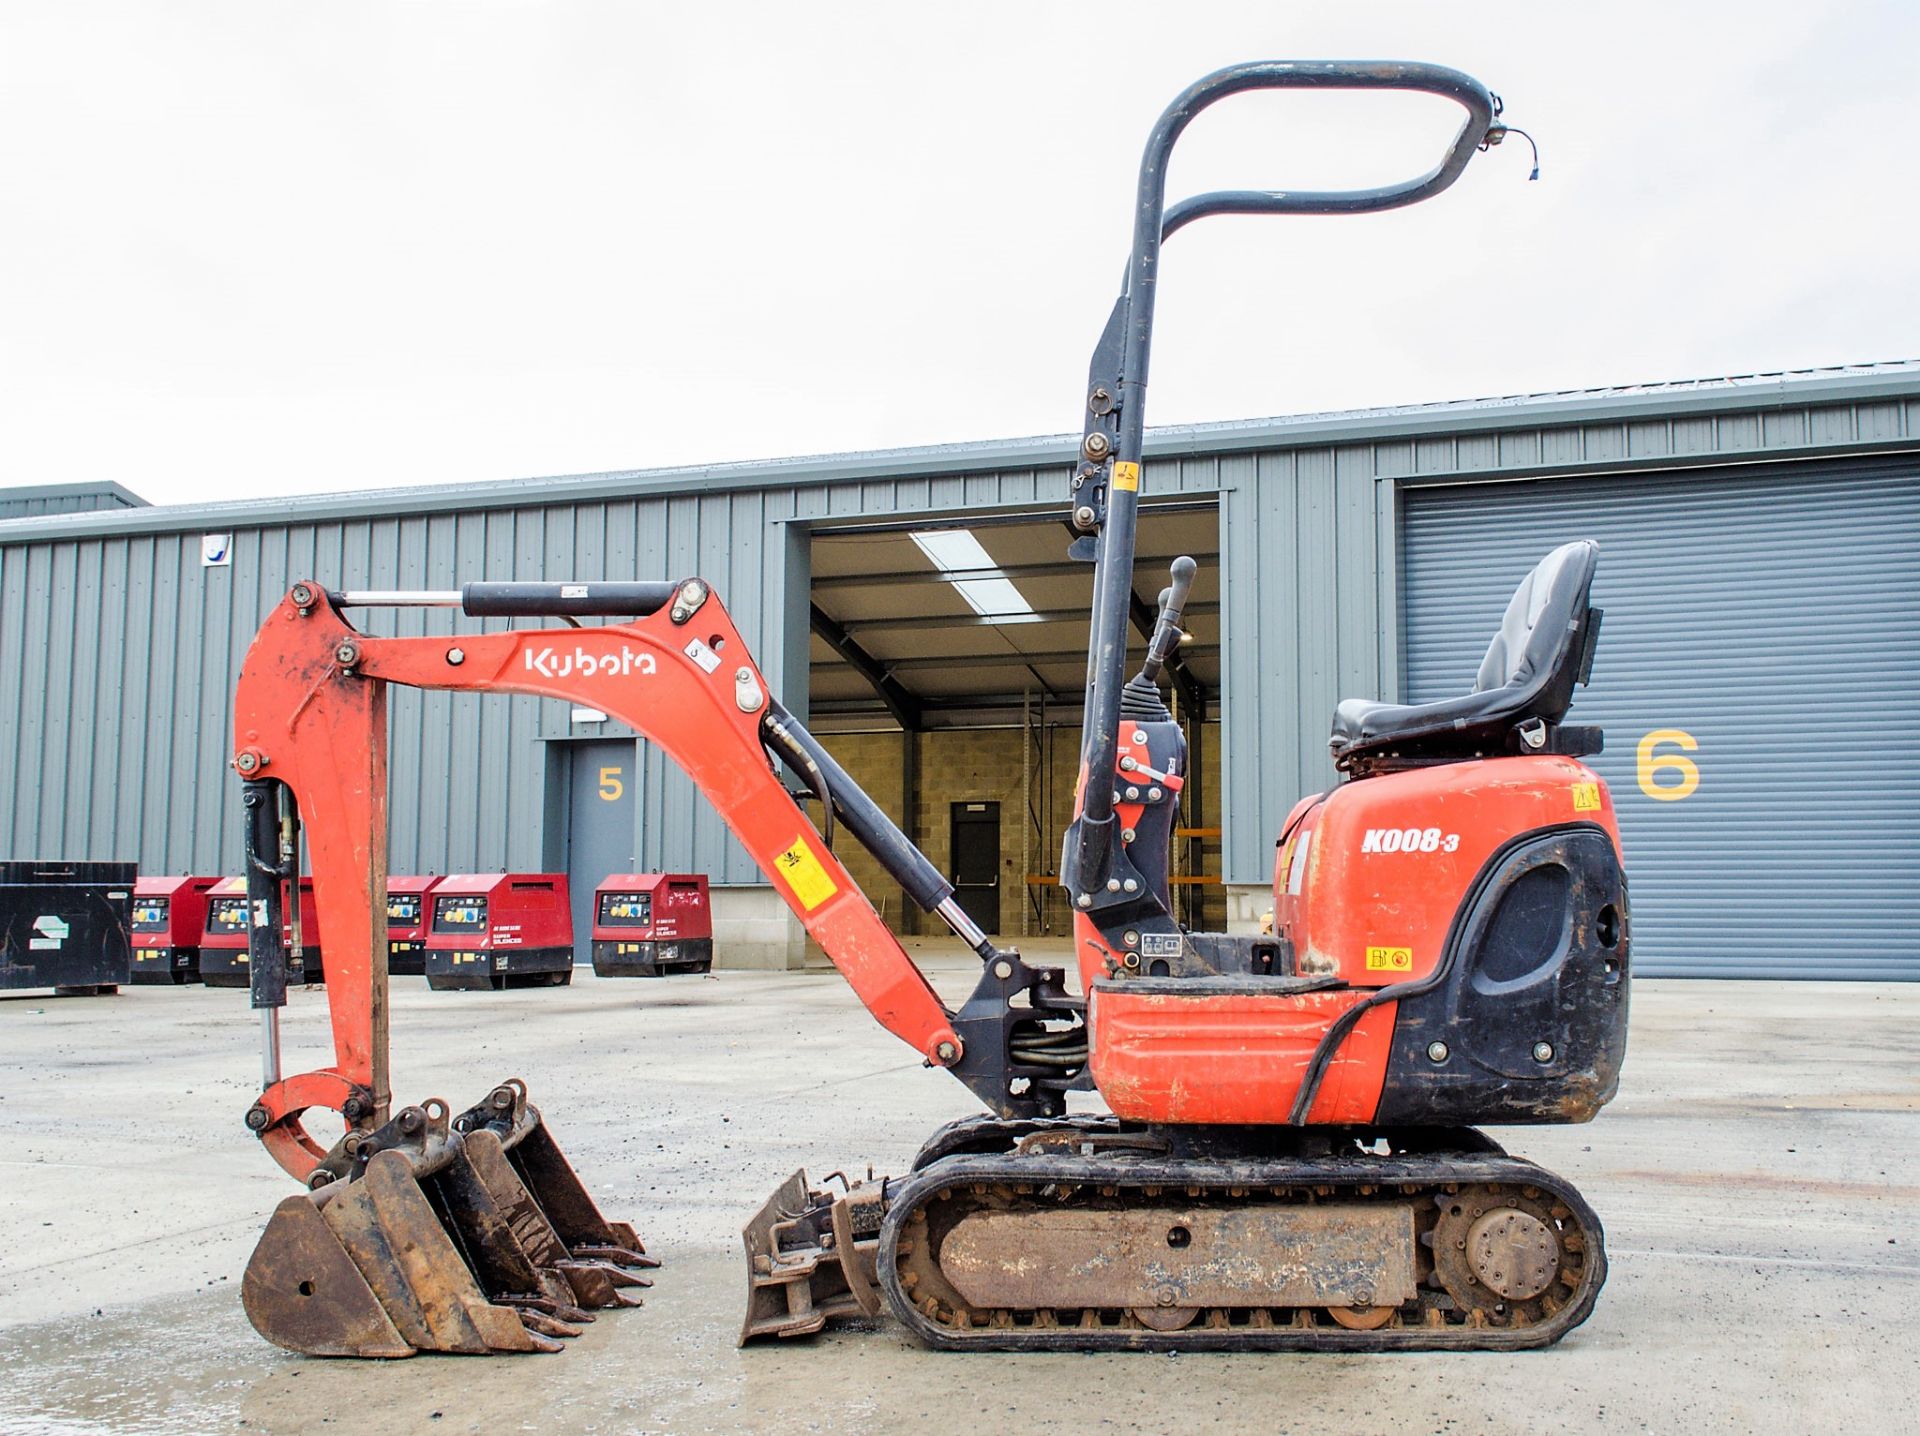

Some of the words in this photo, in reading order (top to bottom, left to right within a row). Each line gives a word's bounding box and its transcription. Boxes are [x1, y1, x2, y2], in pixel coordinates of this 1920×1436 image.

[525, 646, 657, 677] Kubota
[1636, 728, 1700, 801] 6
[599, 767, 623, 801] 5
[1361, 827, 1460, 853] K008-3
